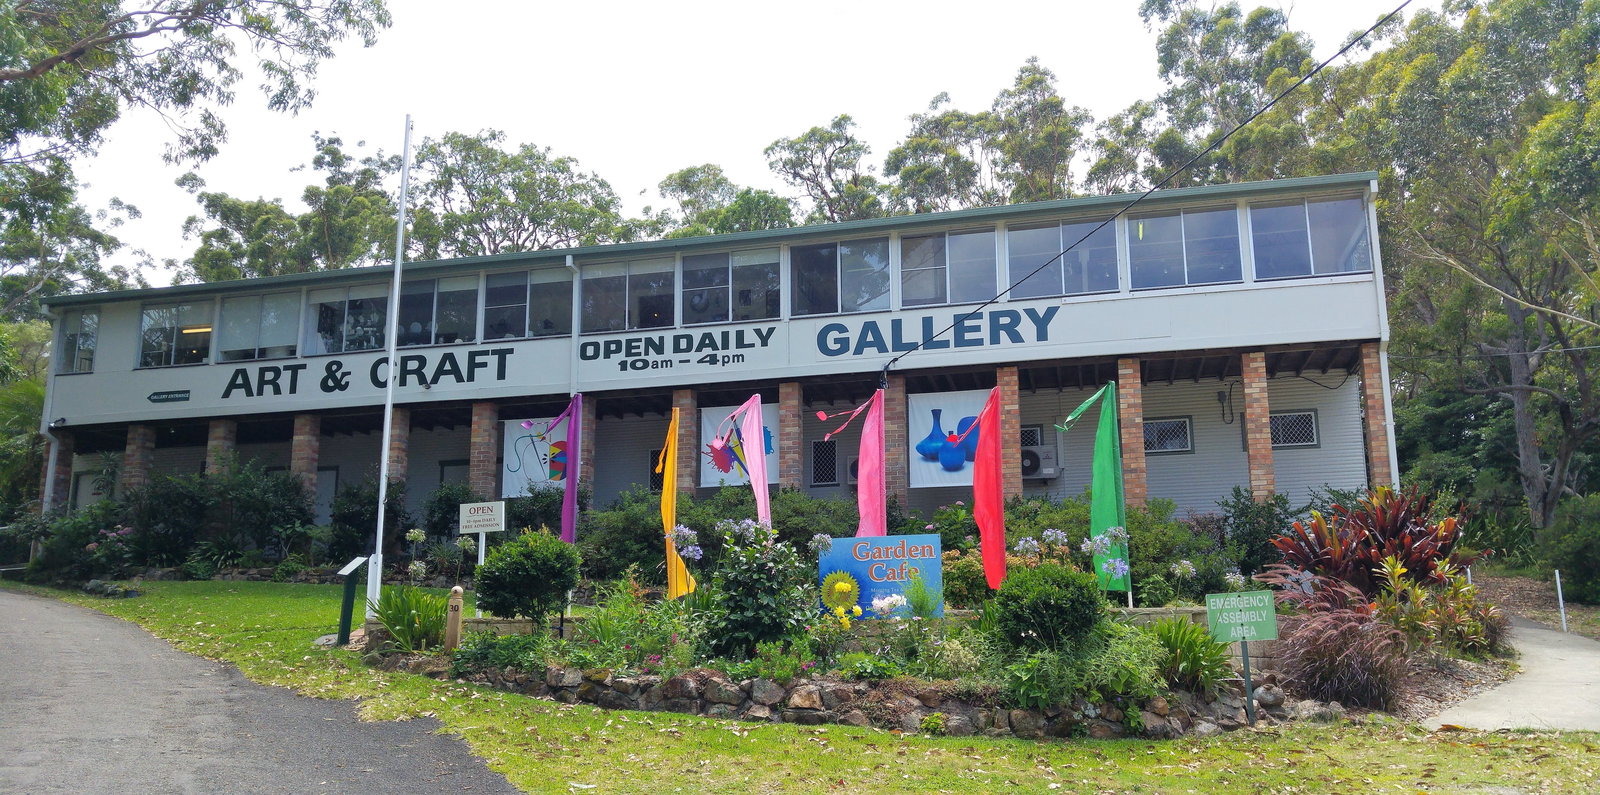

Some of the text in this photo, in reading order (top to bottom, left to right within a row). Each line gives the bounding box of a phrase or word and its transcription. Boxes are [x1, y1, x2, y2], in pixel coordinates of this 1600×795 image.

[816, 305, 1061, 357] GALLERY
[579, 326, 777, 361] OPEN DAILY
[617, 357, 673, 372] 10am
[696, 352, 745, 367] 4pm
[220, 347, 515, 399] ART & CRAFT
[468, 505, 494, 515] OPEN
[851, 539, 937, 562] Garden
[867, 561, 921, 583] Cafe
[449, 604, 460, 612] 30
[1210, 595, 1270, 610] EMERGENCY
[1217, 609, 1268, 624] ASSEMBLY
[1230, 625, 1257, 638] AREA
